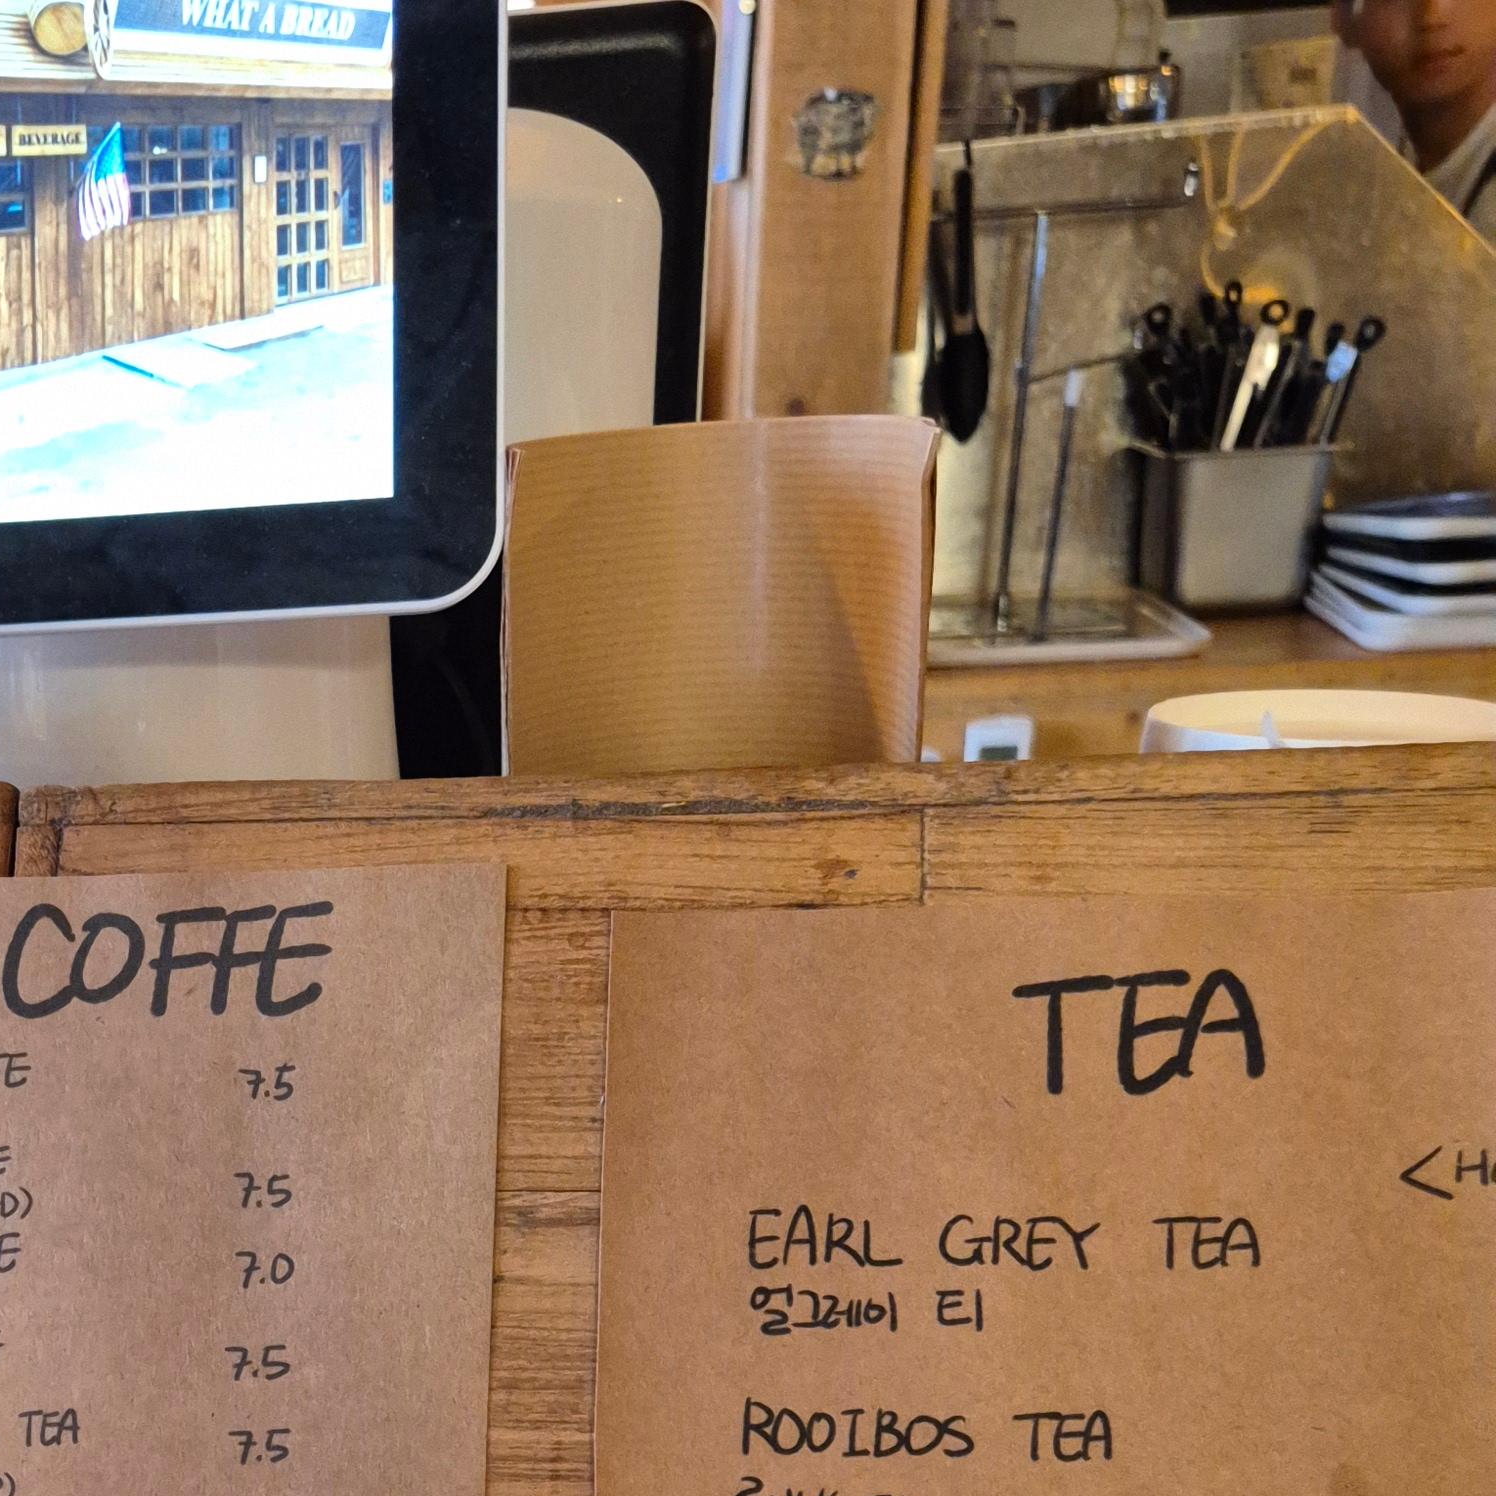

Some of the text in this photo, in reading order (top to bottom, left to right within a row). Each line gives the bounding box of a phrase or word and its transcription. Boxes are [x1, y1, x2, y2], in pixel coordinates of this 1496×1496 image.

[182, 0, 356, 41] WHAT A BREAD
[18, 131, 82, 147] BEVERAGE
[1012, 968, 1266, 1095] TEA
[237, 1063, 297, 1101] 7.5
[233, 1172, 294, 1210] 7.5
[748, 1204, 1262, 1272] EARL GREY TEA
[234, 1249, 295, 1290] 7.0
[750, 1283, 985, 1336] 얼그레이 티
[224, 1343, 291, 1382] 7.5
[18, 1408, 81, 1448] TEA
[228, 1428, 292, 1466] 7.5
[742, 1397, 1114, 1462] ROOIBOS TEA
